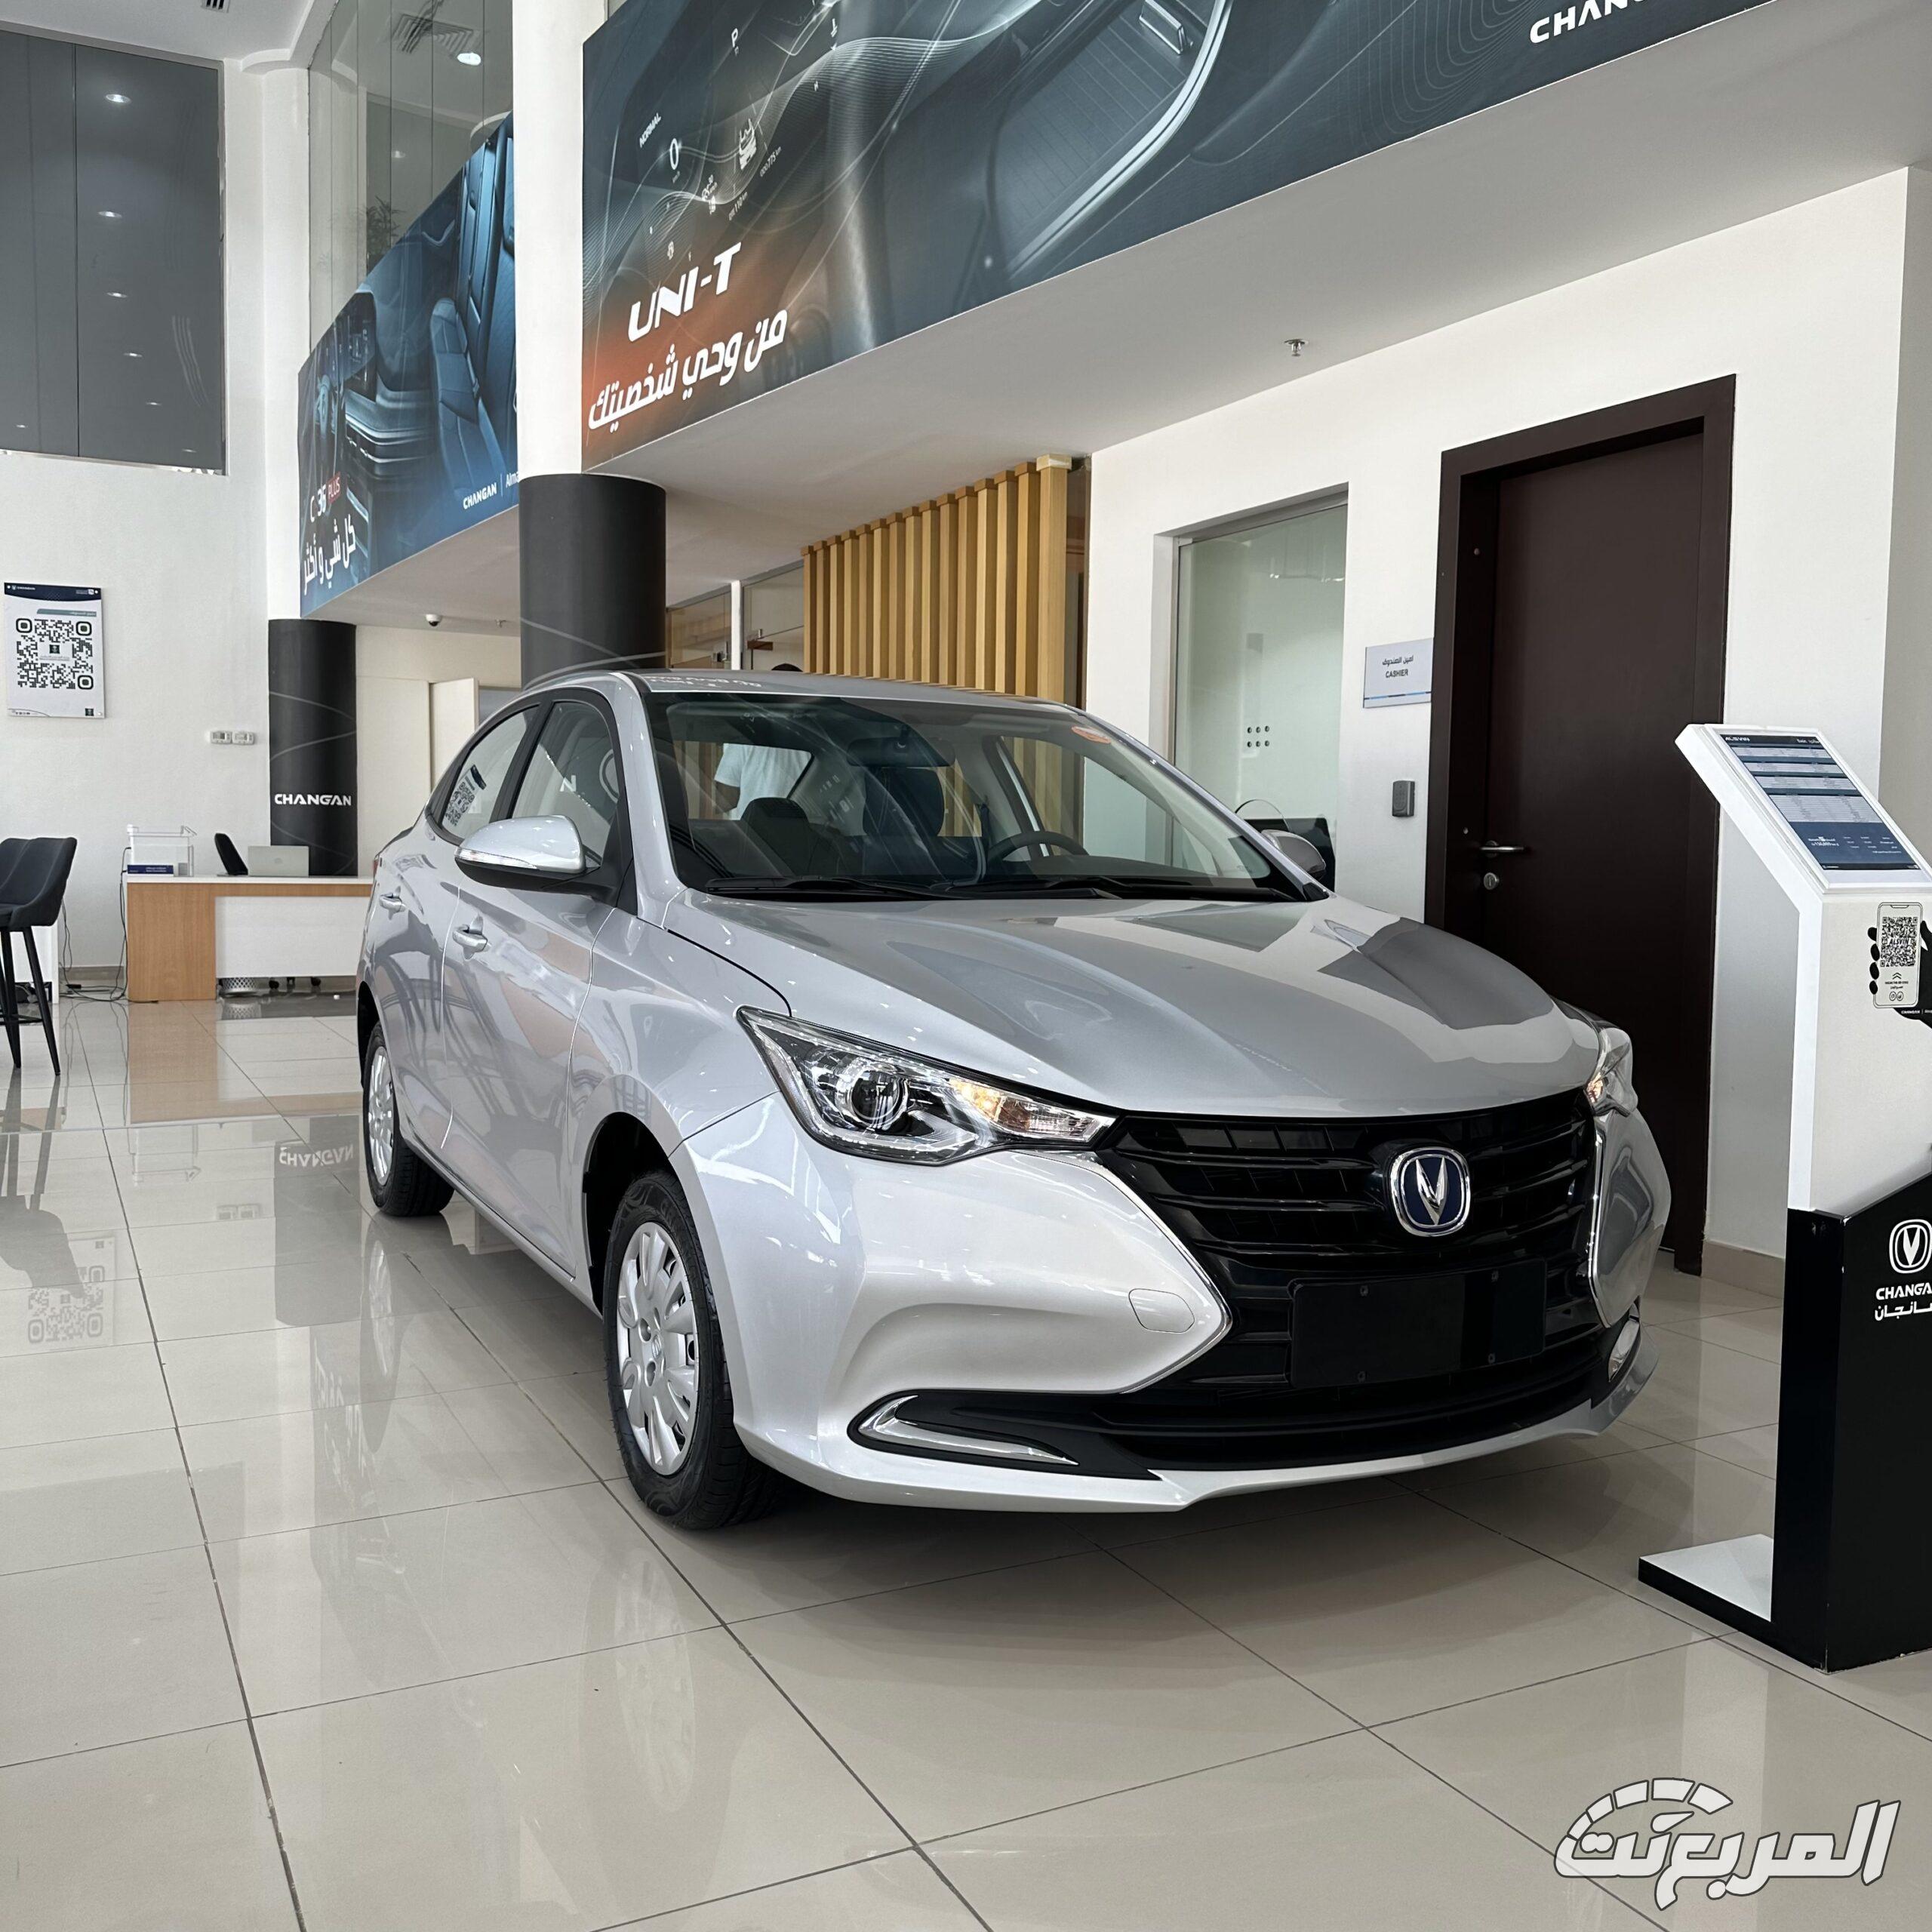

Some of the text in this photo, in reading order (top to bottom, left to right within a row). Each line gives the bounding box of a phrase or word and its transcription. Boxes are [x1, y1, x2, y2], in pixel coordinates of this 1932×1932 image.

[1530, 0, 1644, 44] CHAN
[639, 112, 661, 148] NORMAL
[628, 242, 741, 342] UNI-T
[588, 309, 787, 432] من وحي شخصيتك
[463, 472, 520, 509] CHANGAN Alma
[342, 514, 356, 569] كل
[1385, 669, 1408, 678] CASHIER
[275, 793, 352, 806] CHANGAN
[1875, 1282, 1932, 1300] CHANGA
